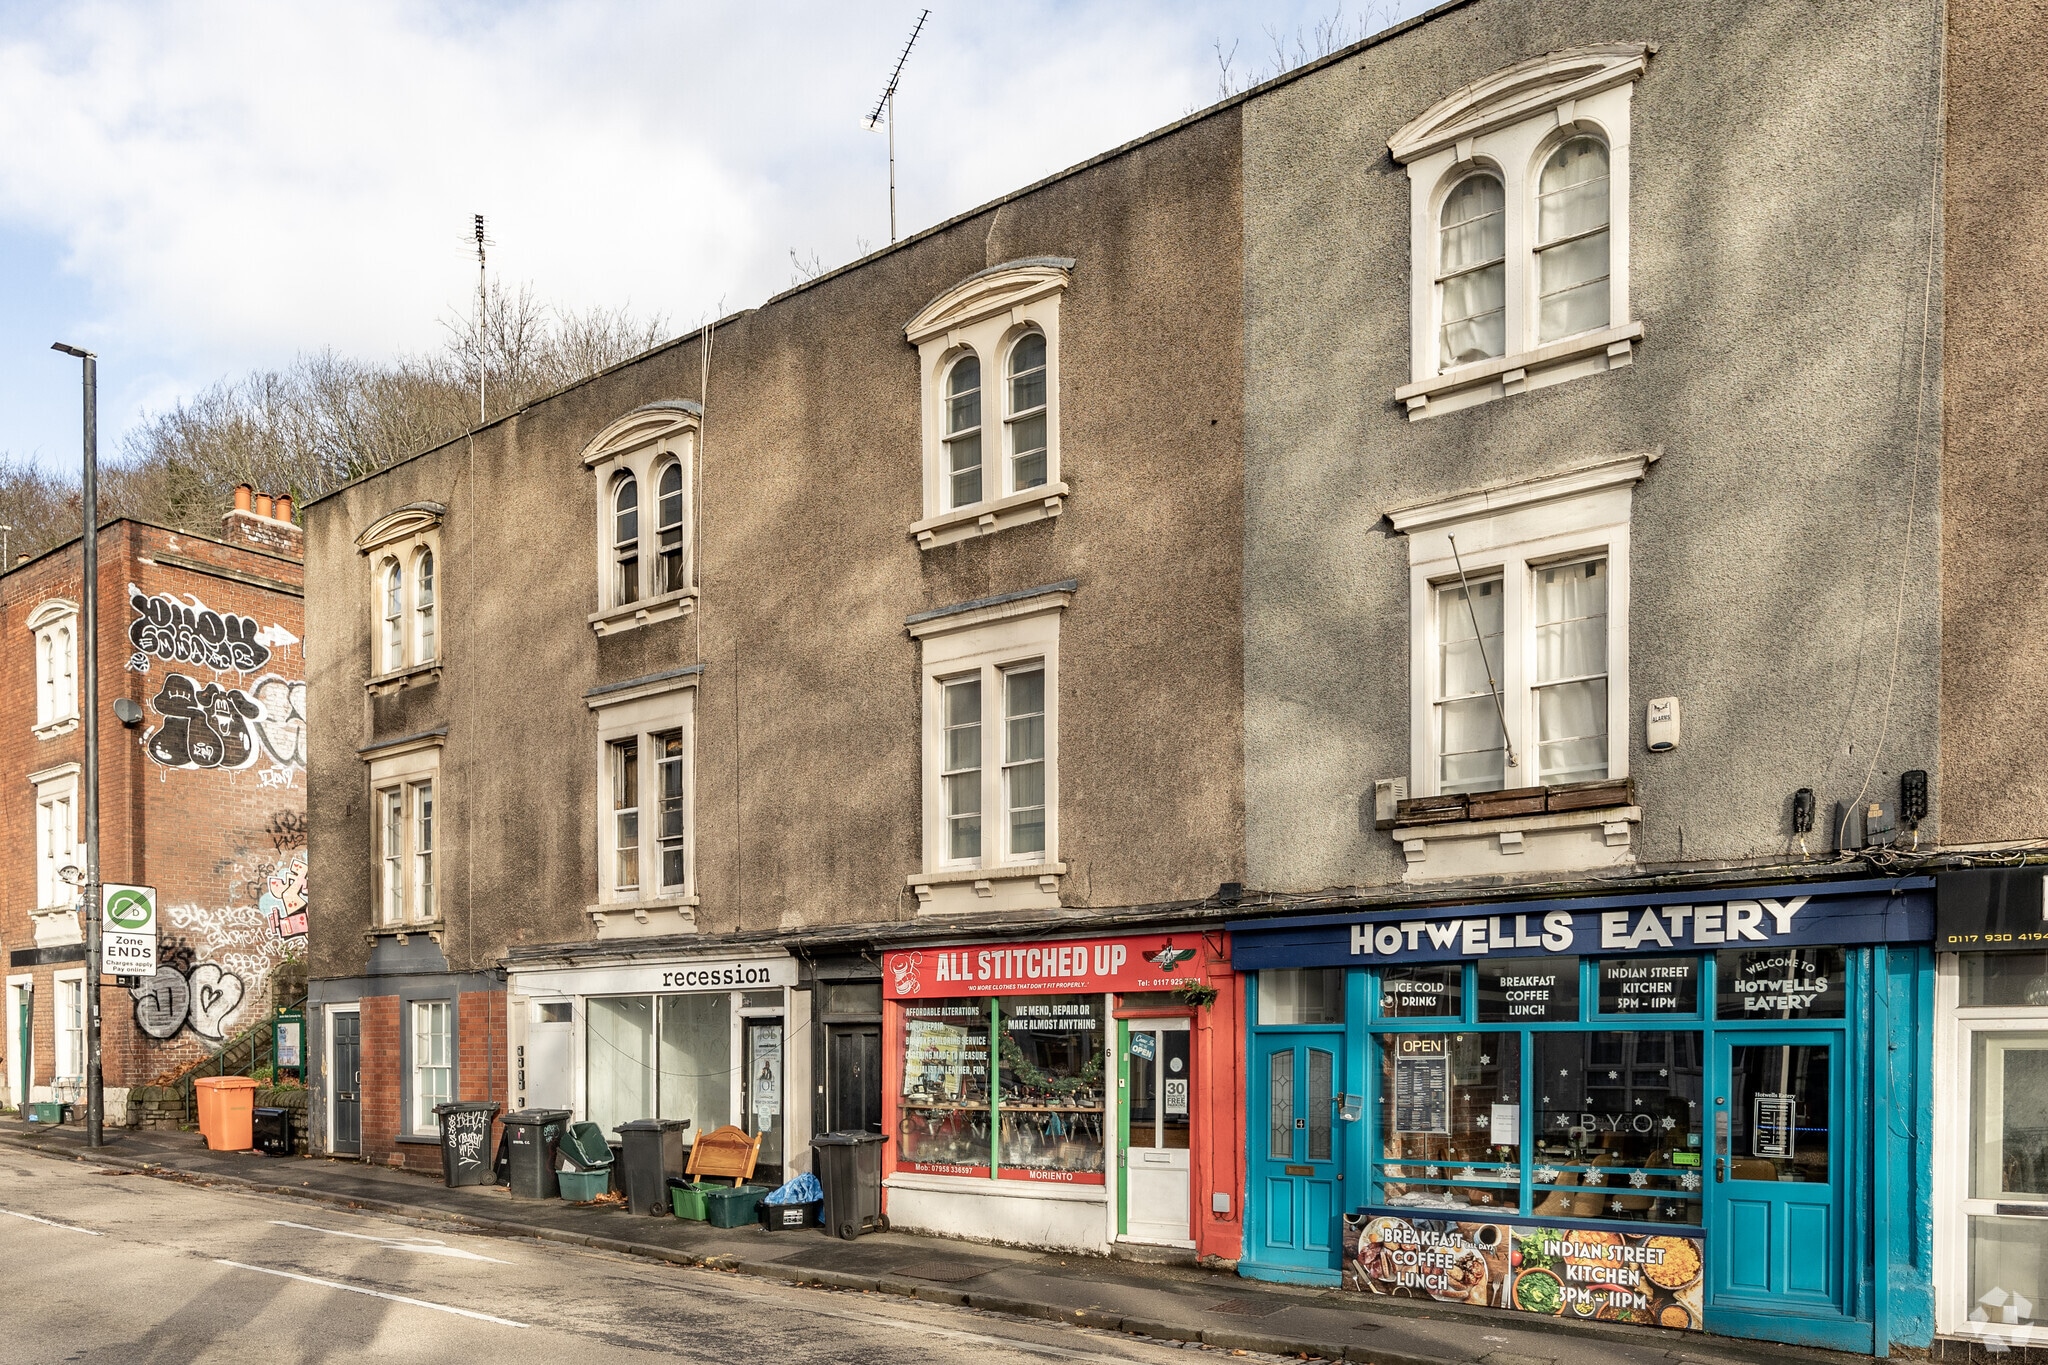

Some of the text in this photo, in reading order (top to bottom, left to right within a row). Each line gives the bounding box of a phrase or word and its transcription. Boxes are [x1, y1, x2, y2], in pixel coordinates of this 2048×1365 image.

[132, 908, 140, 916] D
[1350, 896, 1812, 955] HOTWELLS EATERY
[116, 936, 143, 946] Zone
[1948, 935, 1978, 943] 0117
[1984, 934, 2012, 942] 930
[108, 946, 152, 958] ENDS
[936, 944, 1126, 982] ALL STITCHED UP
[1746, 957, 1816, 975] WELCOME TO
[662, 964, 770, 986] recession
[1608, 966, 1689, 979] INDIAN STREET
[1396, 982, 1444, 993] ICE COLD
[1500, 976, 1556, 987] BREAKFAST
[1734, 976, 1828, 994] HOTWELLS
[1622, 982, 1672, 994] KITCHEN
[1402, 996, 1436, 1007] DRINKS
[1505, 990, 1549, 1001] COFFEE
[1618, 998, 1639, 1009] 5PM
[1651, 997, 1676, 1009] 11PM
[1744, 994, 1817, 1011] EATERY
[906, 1006, 980, 1016] AFFORDABLE ALTERATIONS
[1016, 1004, 1090, 1017] WE MEND, REPAIR OR
[1509, 1005, 1545, 1016] LUNCH
[923, 1022, 944, 1031] REPAIR
[1008, 1019, 1096, 1030] MAKE ALMOST ANYTHING
[932, 1036, 960, 1045] TAILORING
[962, 1036, 987, 1045] SERVICE
[1403, 1040, 1441, 1052] OPEN
[933, 1051, 951, 1060] MADE
[1106, 1048, 1112, 1057] 6
[1132, 1045, 1152, 1058] OPEN
[945, 1066, 972, 1076] LEATHER,
[973, 1066, 985, 1075] FUR
[1167, 1083, 1185, 1094] 30
[931, 1164, 949, 1173] 07958
[951, 1166, 972, 1174] 336597
[1029, 1170, 1073, 1181] MORIENTO
[1384, 1228, 1463, 1248] BREAKFAST
[1544, 1240, 1665, 1265] INDIAN STREET
[1392, 1251, 1454, 1268] COFFEE
[1396, 1272, 1448, 1290] LUNCH
[1566, 1265, 1640, 1286] KITCHEN
[1559, 1286, 1590, 1304] 5PM
[1609, 1291, 1646, 1310] 11PM
